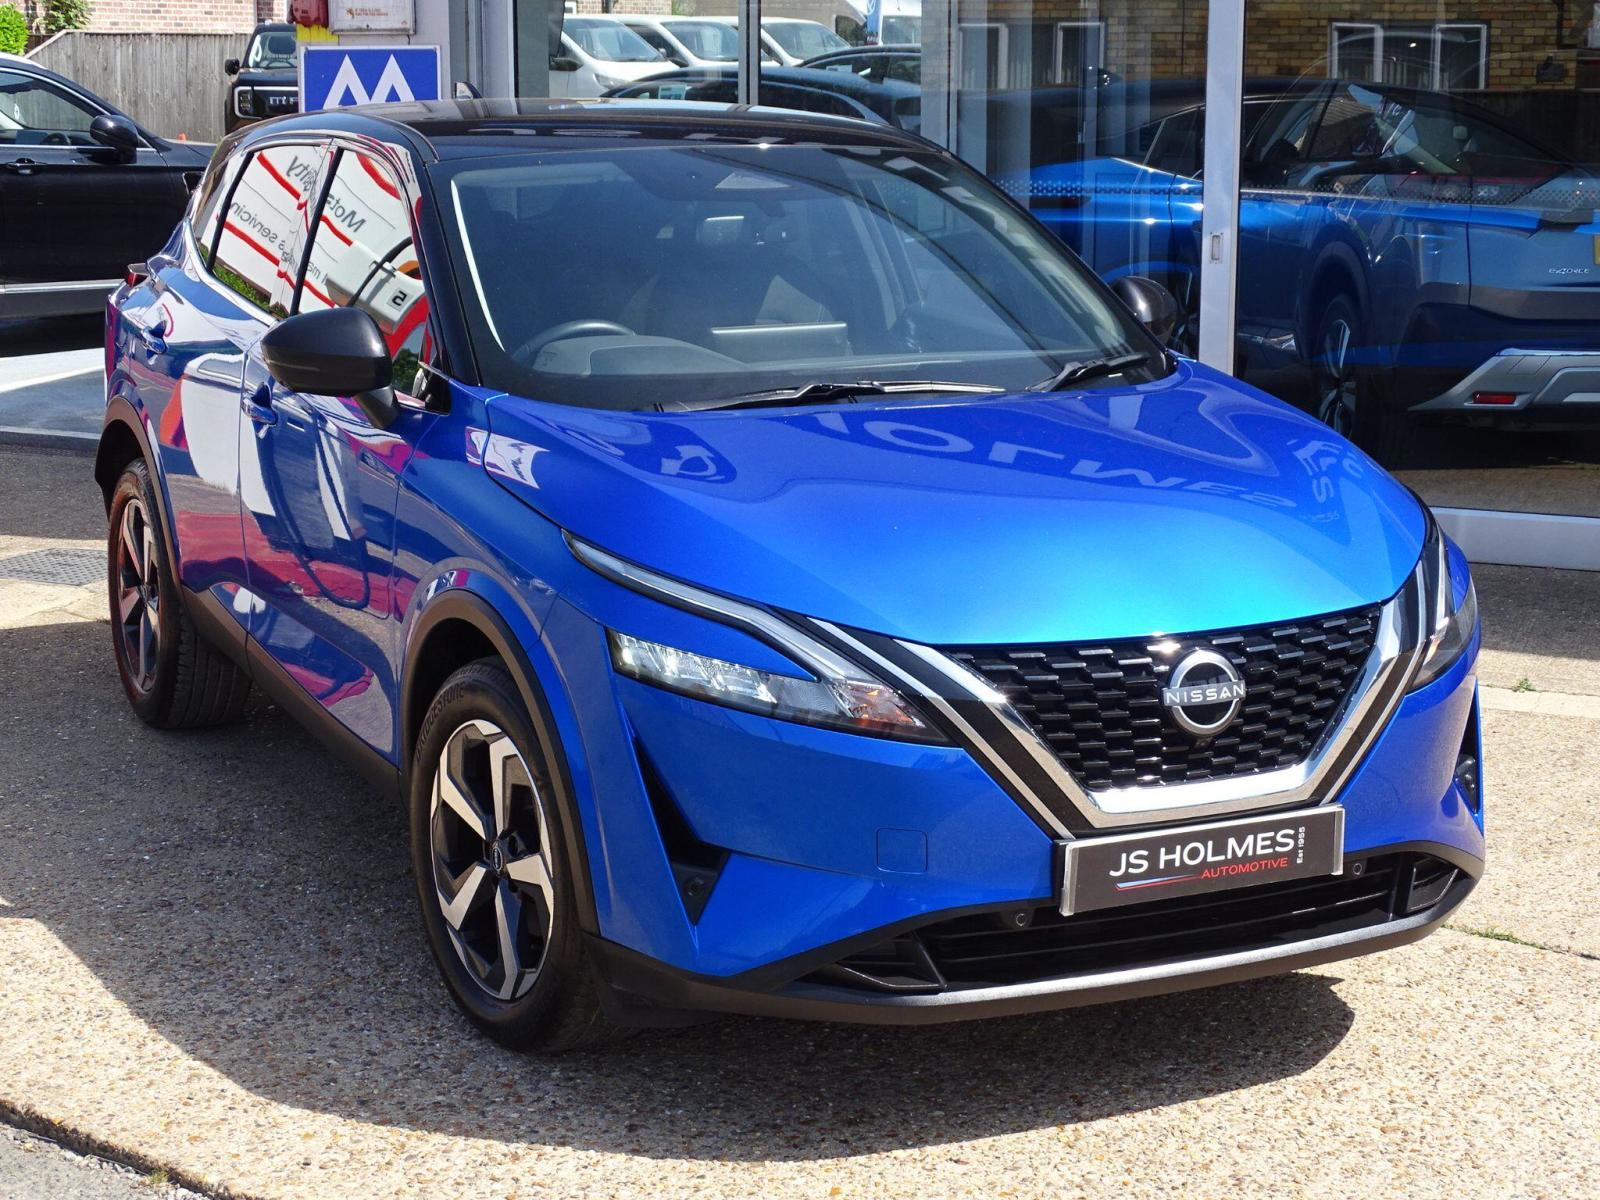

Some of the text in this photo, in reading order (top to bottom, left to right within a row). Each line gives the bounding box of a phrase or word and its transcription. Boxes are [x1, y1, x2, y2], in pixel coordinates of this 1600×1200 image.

[1166, 684, 1244, 704] NISSAN
[1297, 826, 1306, 848] 1955
[1109, 829, 1295, 877] JS HOLMES
[1201, 857, 1288, 879] AUTOMOTIVE
